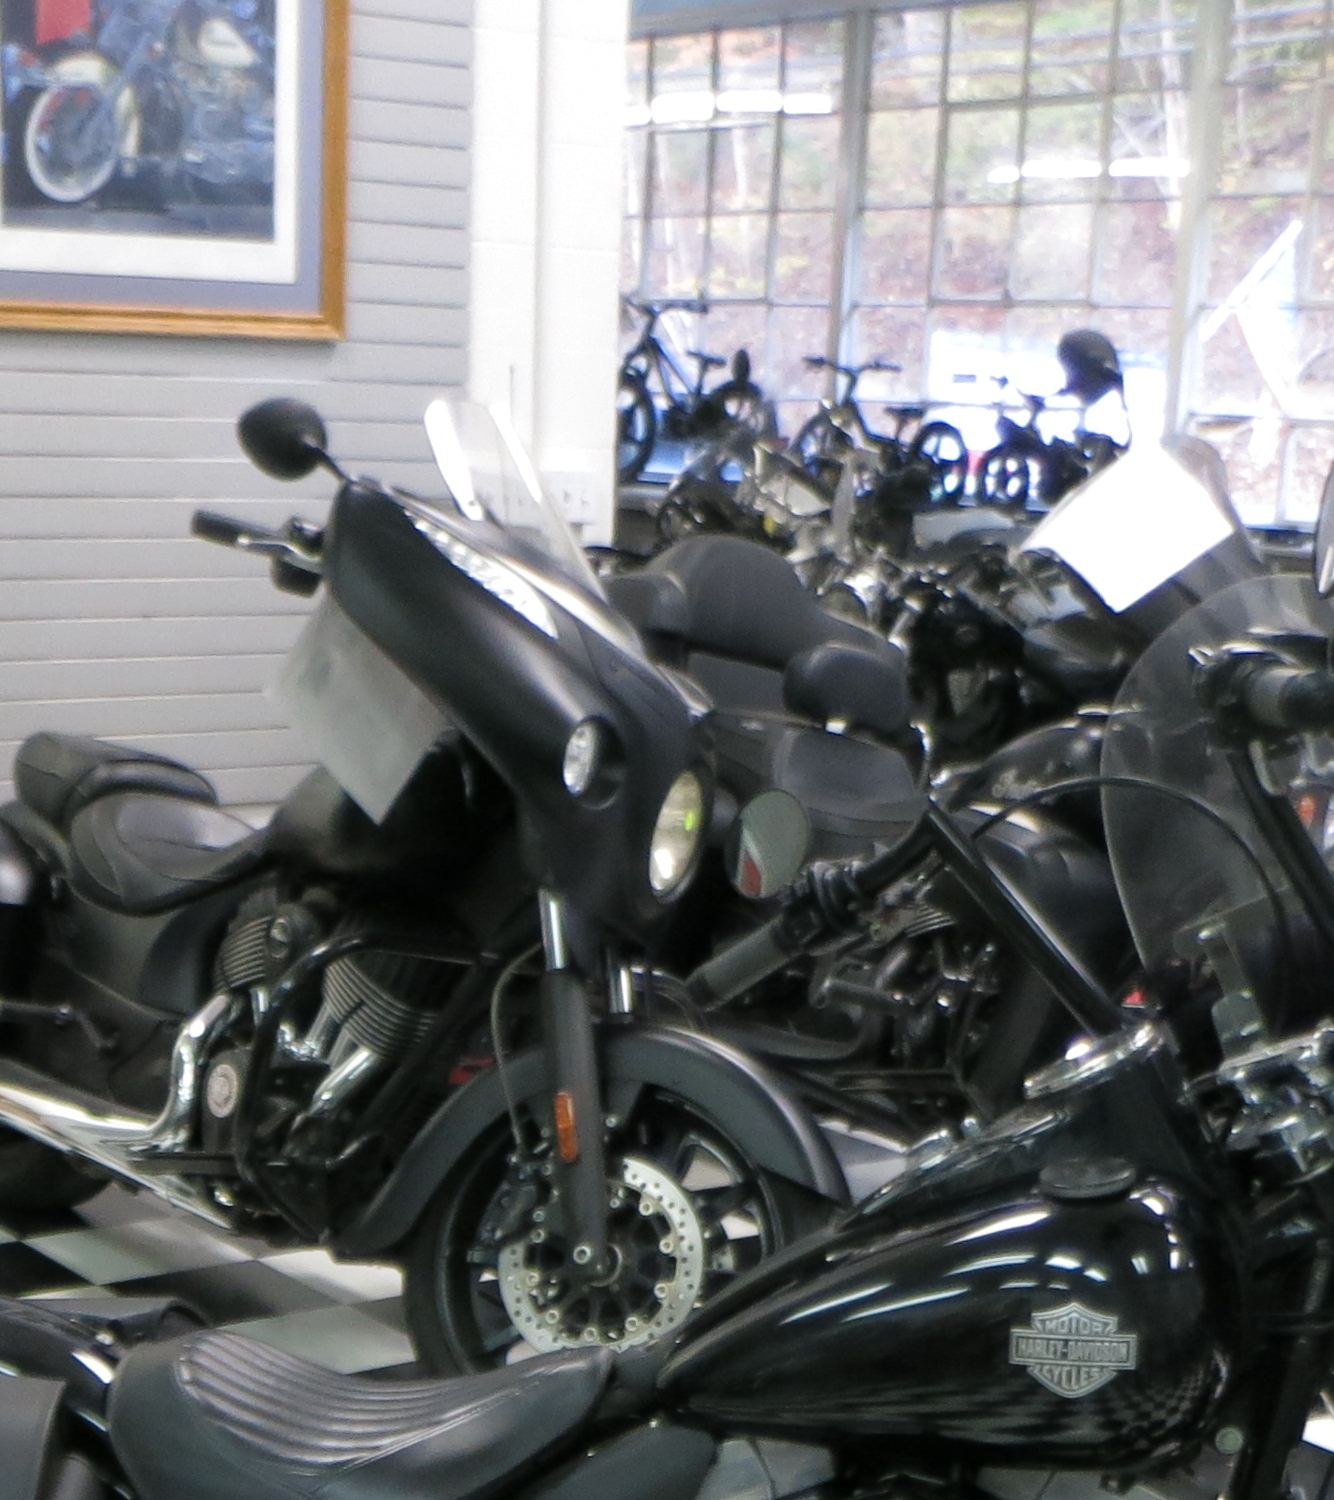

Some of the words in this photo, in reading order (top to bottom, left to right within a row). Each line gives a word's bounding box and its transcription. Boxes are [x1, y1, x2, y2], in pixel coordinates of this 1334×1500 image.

[1045, 1313, 1103, 1334] MOTOR
[1018, 1338, 1128, 1361] HARLEY-DAVIDSON
[1041, 1365, 1100, 1389] CYCLES
